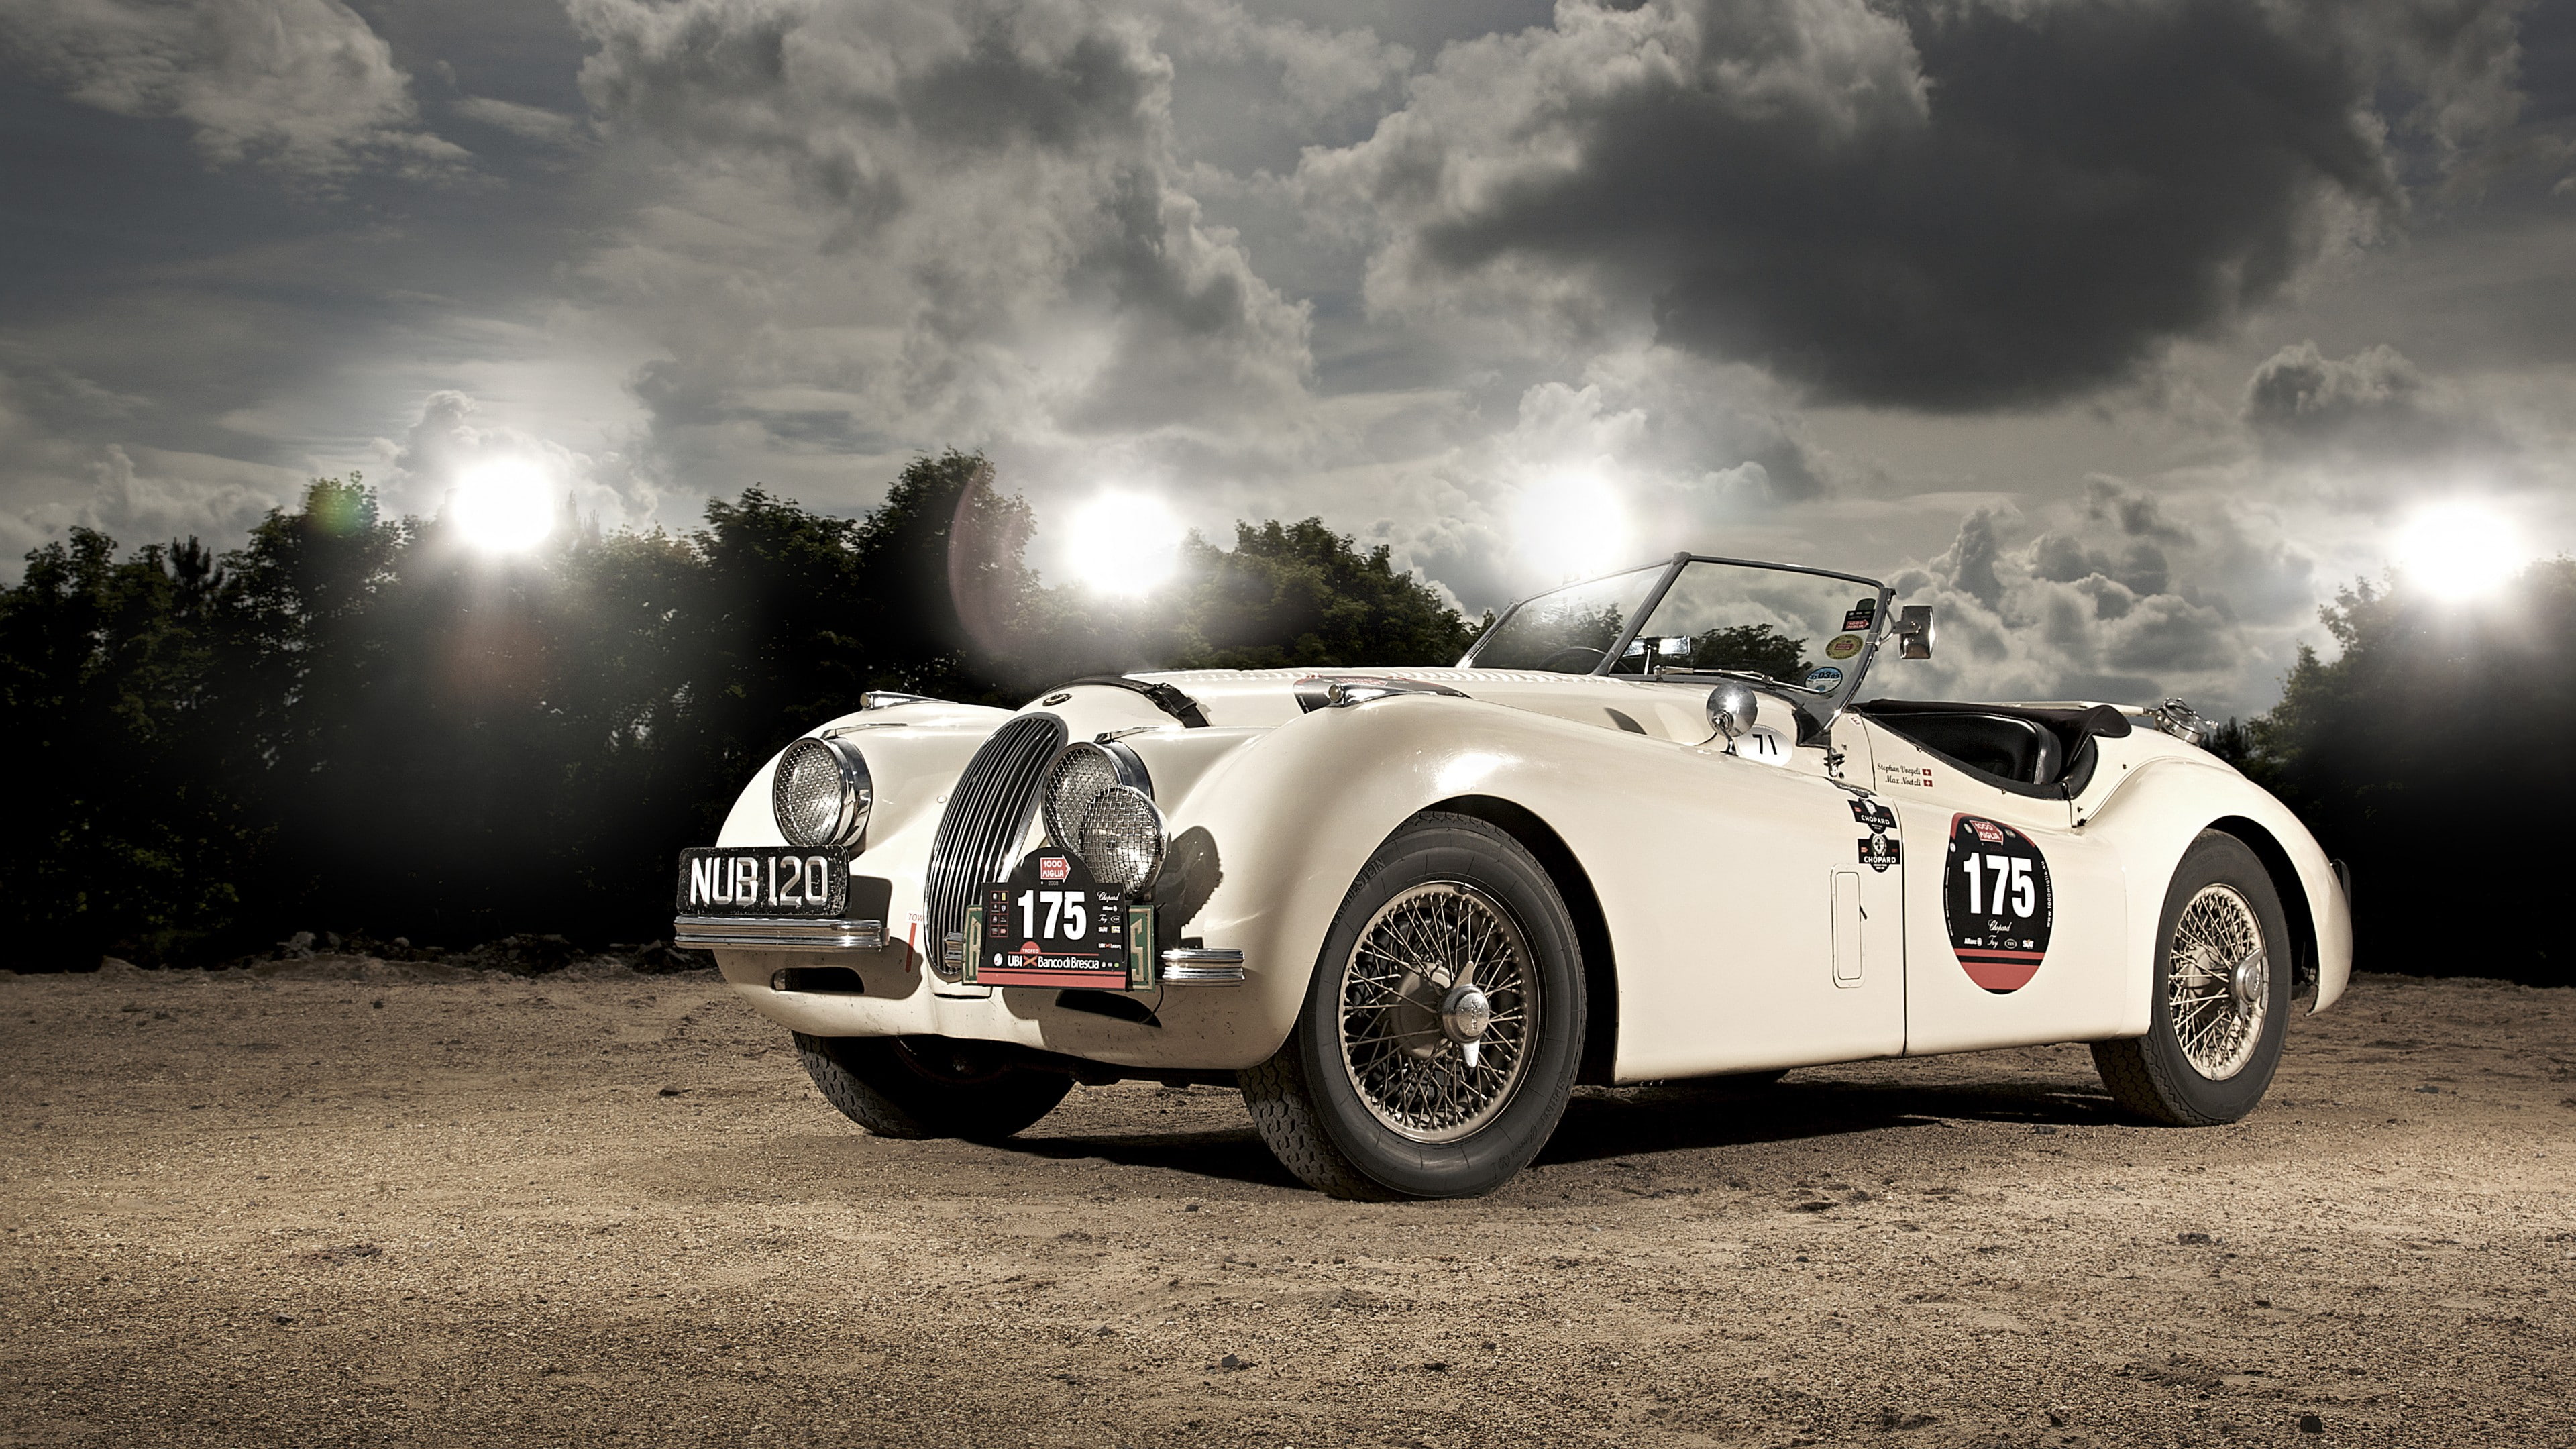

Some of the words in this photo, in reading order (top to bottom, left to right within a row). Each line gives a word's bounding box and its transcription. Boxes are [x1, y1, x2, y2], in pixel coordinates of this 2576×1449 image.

[1752, 734, 1777, 755] 71
[1885, 775, 1900, 784] Max
[1861, 815, 1890, 825] CHOPARD
[1974, 823, 1994, 831] 1000
[1864, 855, 1896, 863] CHOPARD
[1042, 869, 1064, 877] MIGLIA
[690, 857, 759, 906] NUB
[768, 855, 828, 906] 120
[1963, 852, 2035, 918] 175
[1097, 891, 1120, 903] Chopard
[908, 913, 924, 922] TOW
[1018, 890, 1087, 940] 175
[1988, 919, 2012, 933] Chopard
[1008, 955, 1022, 967] UBI
[1038, 957, 1063, 968] Banco
[1063, 957, 1071, 968] di
[1071, 957, 1099, 969] Brescia
